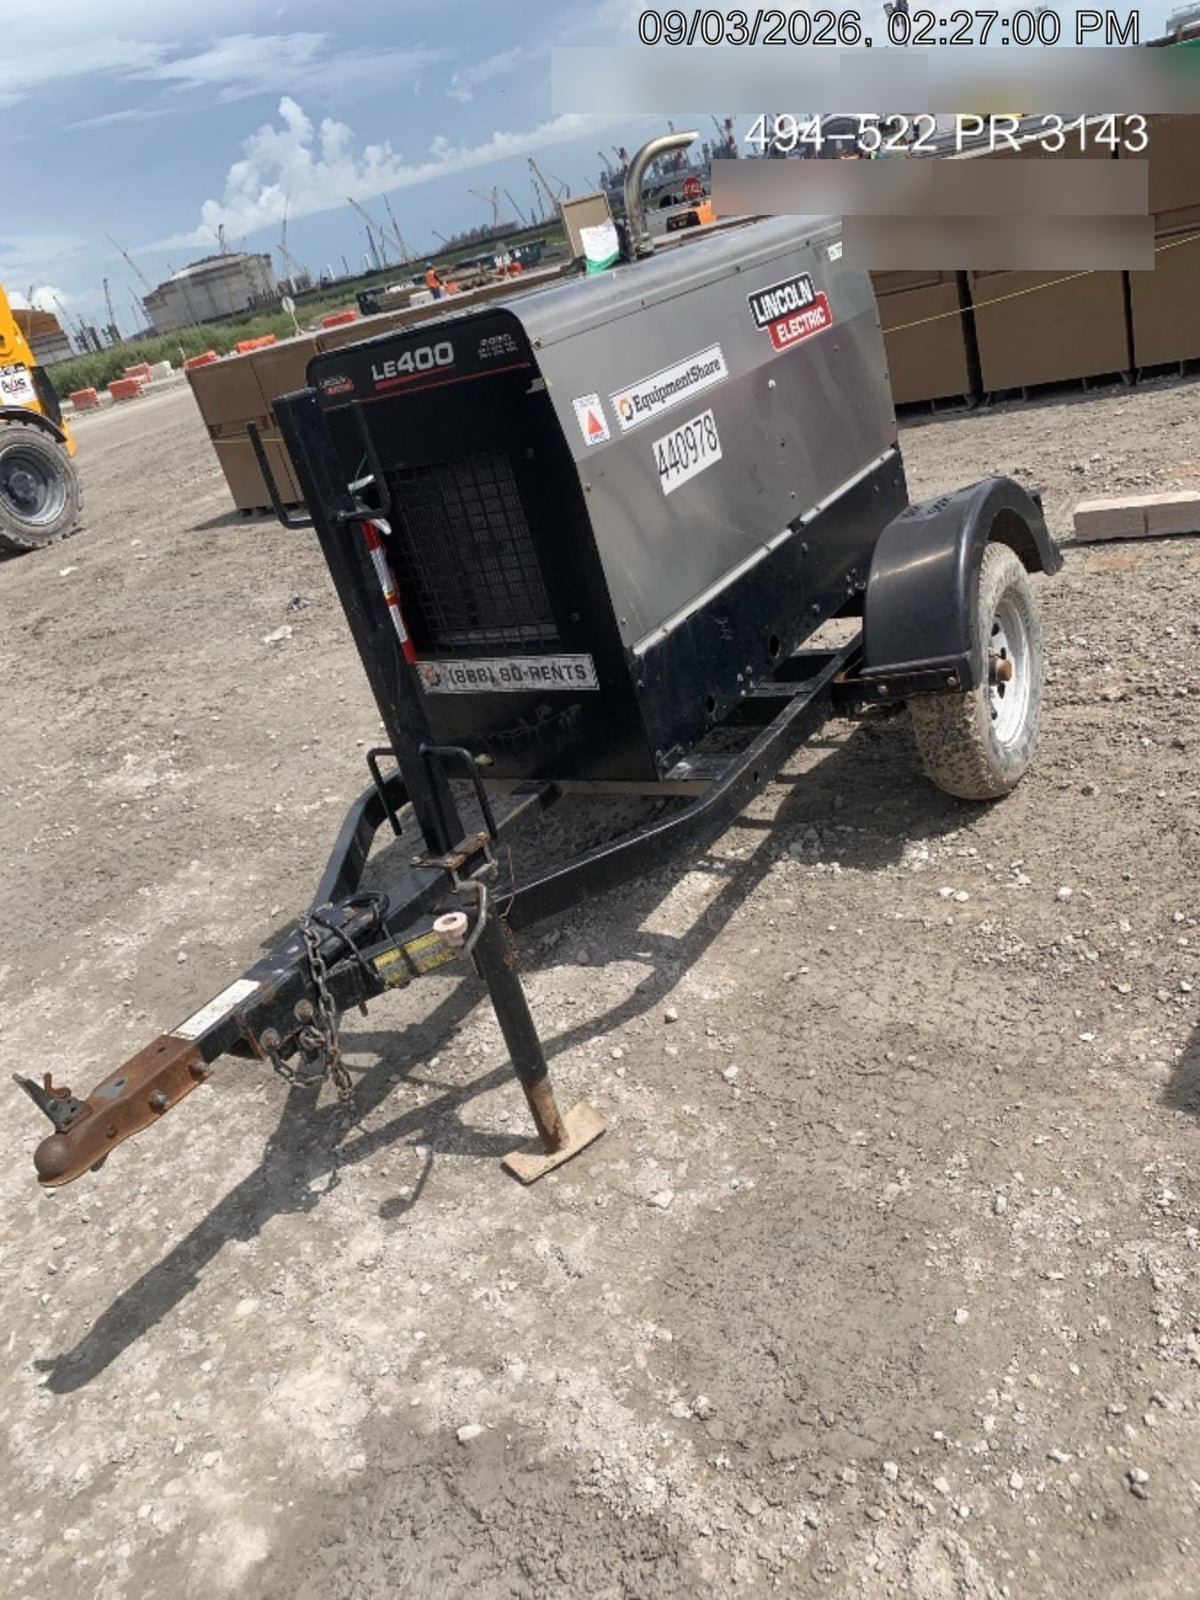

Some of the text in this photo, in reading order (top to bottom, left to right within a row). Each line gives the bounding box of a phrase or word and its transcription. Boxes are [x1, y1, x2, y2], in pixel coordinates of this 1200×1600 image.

[752, 277, 814, 324] LINCOLN
[775, 306, 826, 343] ELECTRIC
[371, 340, 455, 381] LE400
[631, 358, 722, 413] EquipmentShare
[657, 413, 718, 481] 440978
[449, 666, 495, 685] (888)
